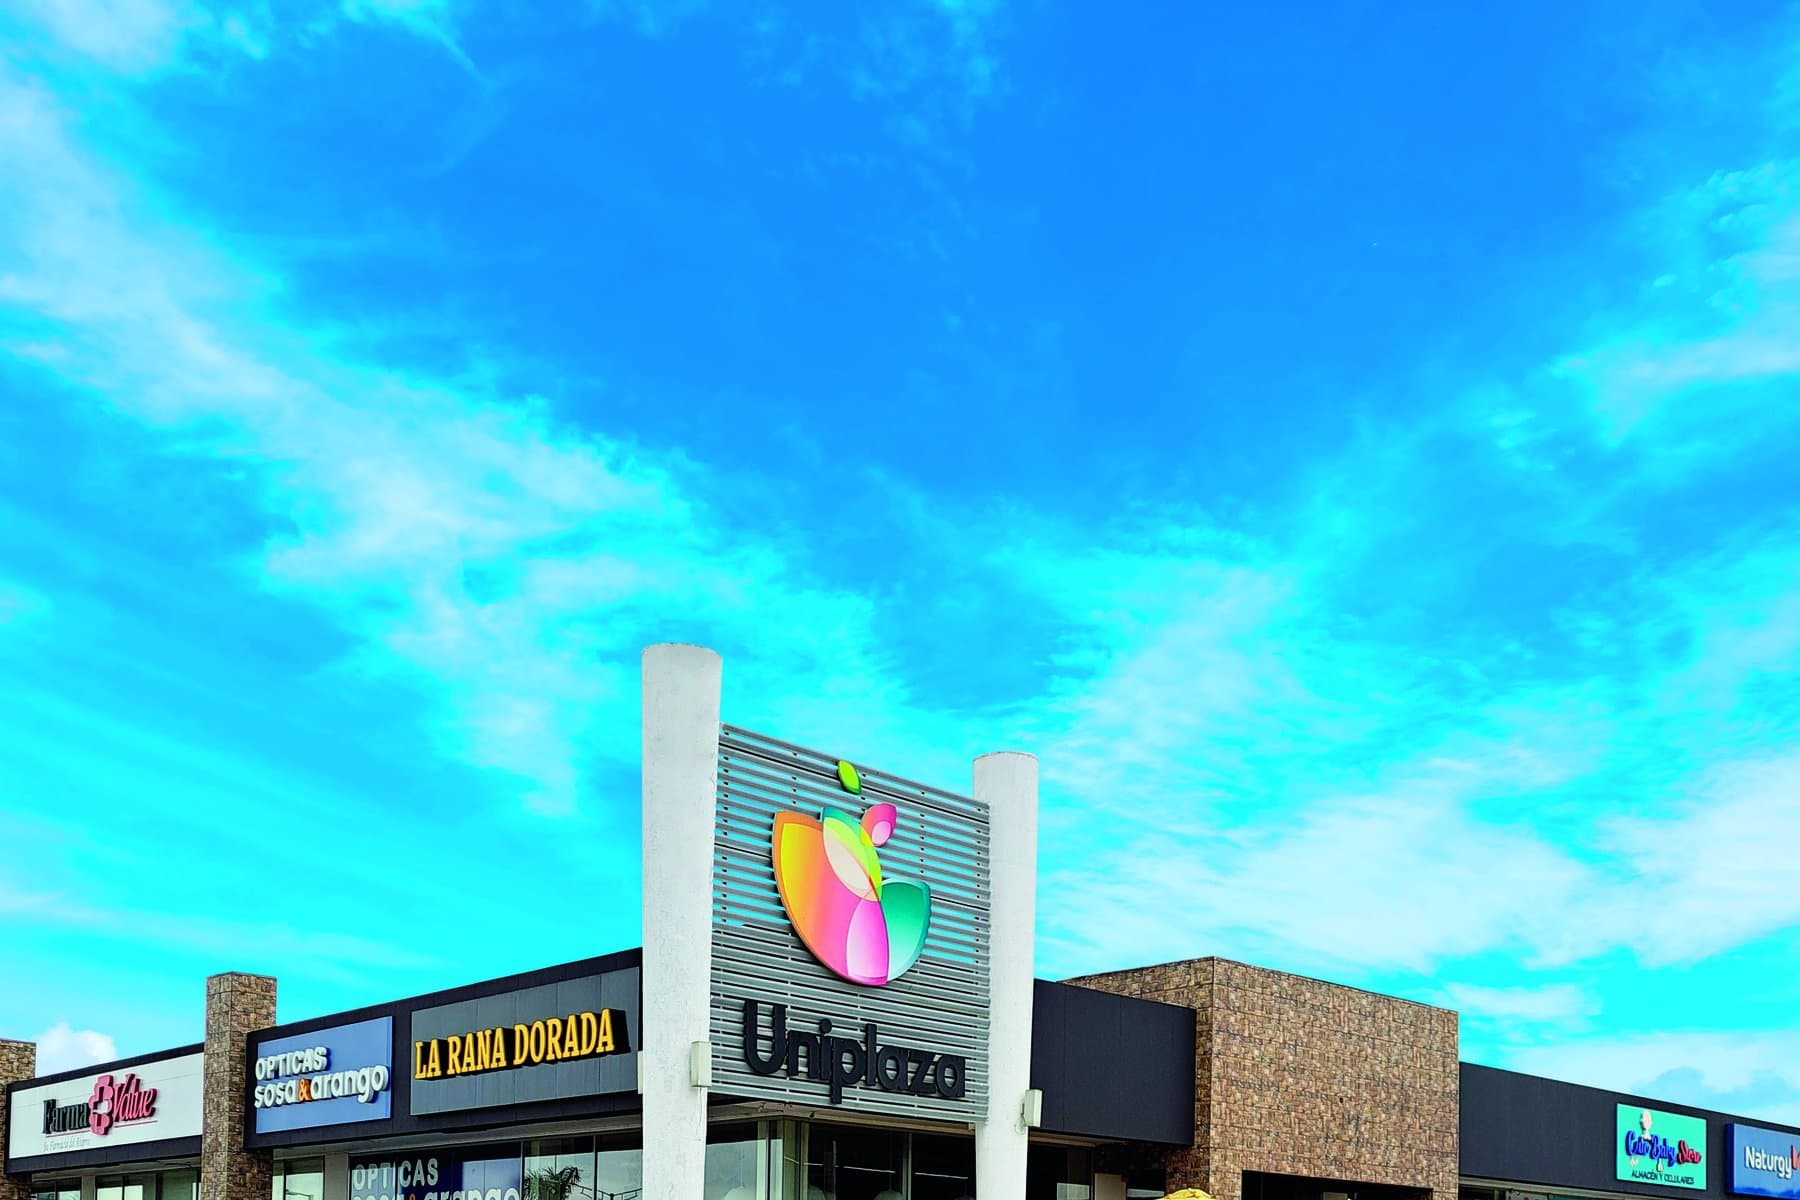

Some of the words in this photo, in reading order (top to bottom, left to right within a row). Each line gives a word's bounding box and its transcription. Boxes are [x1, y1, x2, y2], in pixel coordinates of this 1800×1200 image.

[414, 1039, 442, 1080] LA
[446, 1026, 507, 1075] RANA
[512, 1008, 616, 1066] DORADA
[743, 999, 966, 1104] Uniplaza
[255, 1046, 329, 1081] OPTICAS
[353, 1157, 439, 1191] OPTICAS
[1664, 1173, 1695, 1185] CELULARES
[1744, 1145, 1792, 1180] Naturgy
